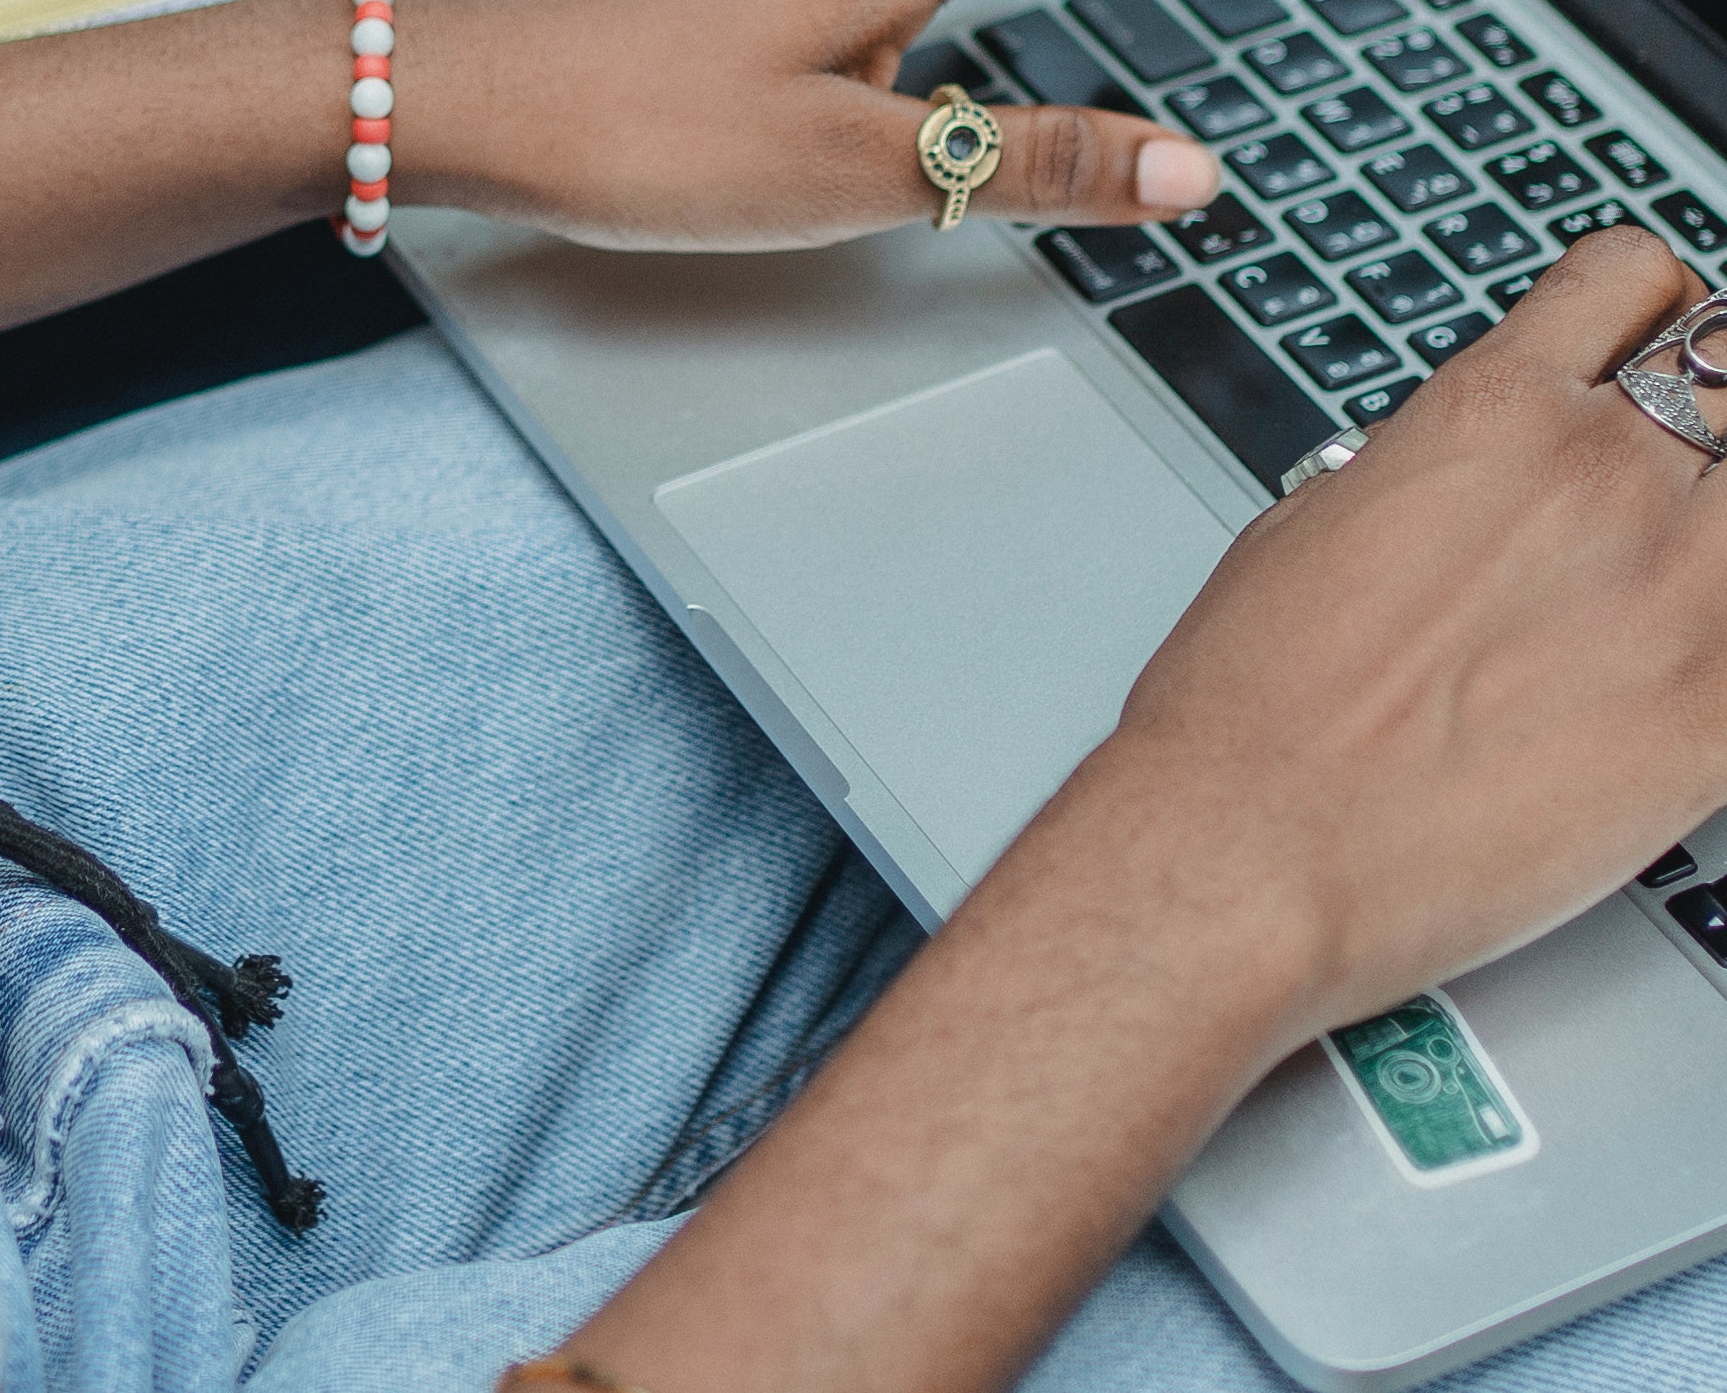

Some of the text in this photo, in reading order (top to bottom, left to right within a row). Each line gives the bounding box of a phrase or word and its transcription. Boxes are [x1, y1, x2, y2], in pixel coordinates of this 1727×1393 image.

[1435, 211, 1468, 236] R
[1234, 265, 1268, 289] C
[1358, 260, 1391, 280] F
[1297, 325, 1330, 347] V
[1424, 325, 1457, 349] G
[1358, 389, 1390, 412] B
